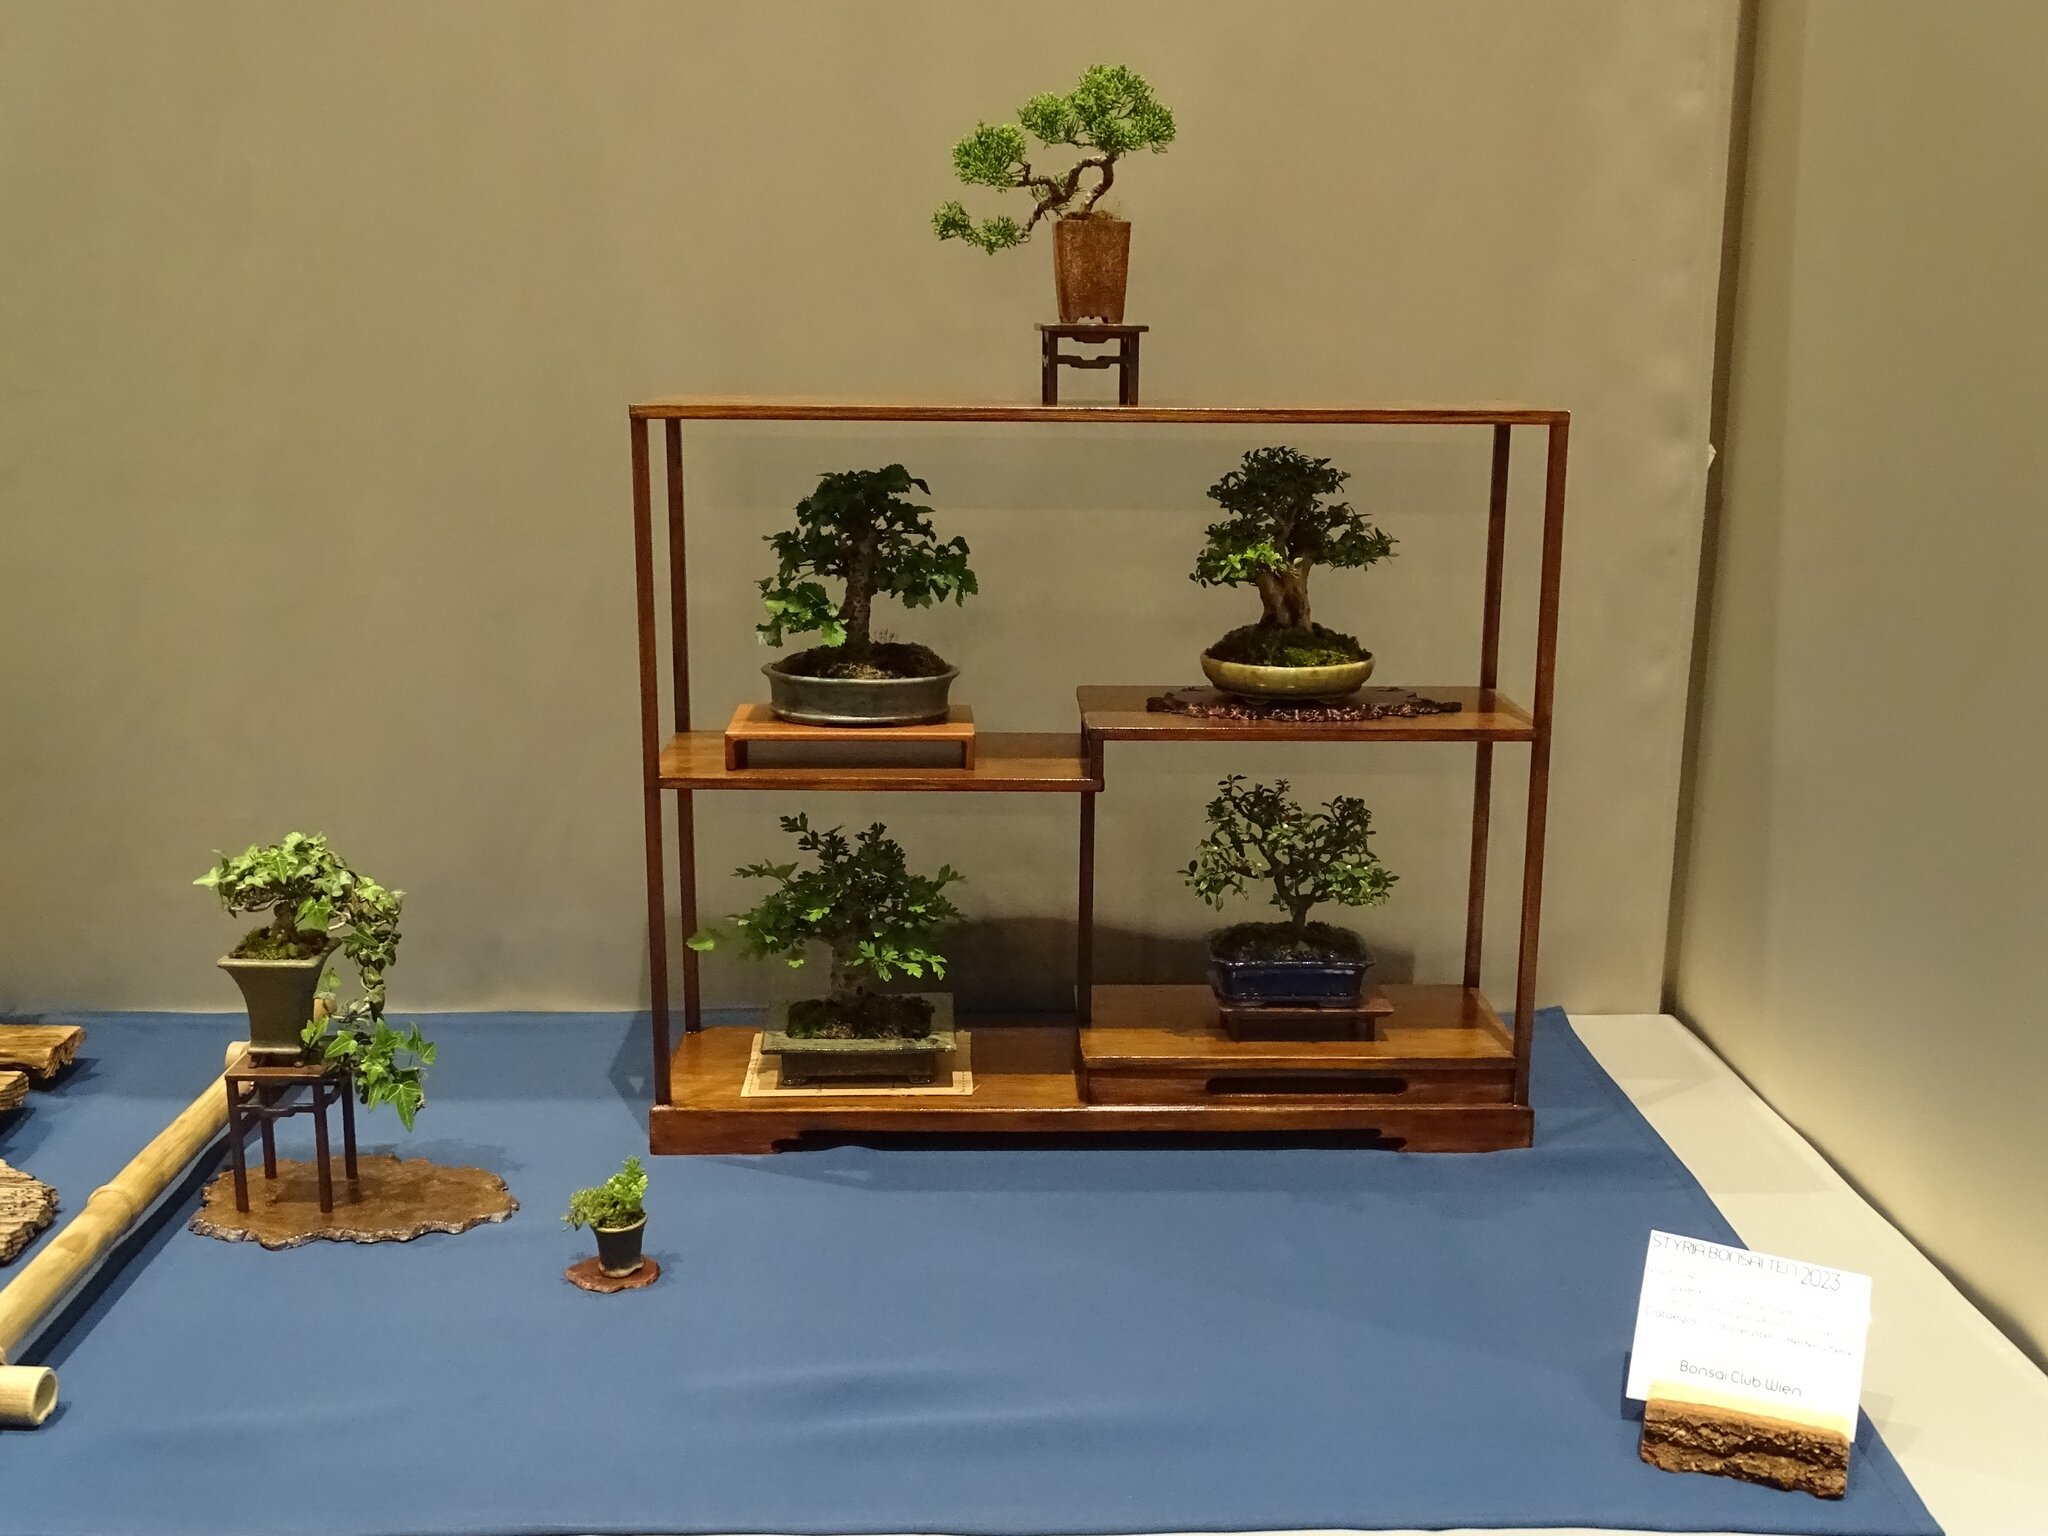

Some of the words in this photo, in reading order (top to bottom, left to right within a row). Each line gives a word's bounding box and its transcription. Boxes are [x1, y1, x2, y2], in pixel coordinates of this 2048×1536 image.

[1652, 1234, 1706, 1257] STYRIA
[1708, 1245, 1763, 1269] BONSAI
[1800, 1266, 1842, 1292] 2023
[1679, 1359, 1728, 1381] Bonsai
[1730, 1371, 1762, 1389] Club
[1765, 1378, 1803, 1397] Wien
